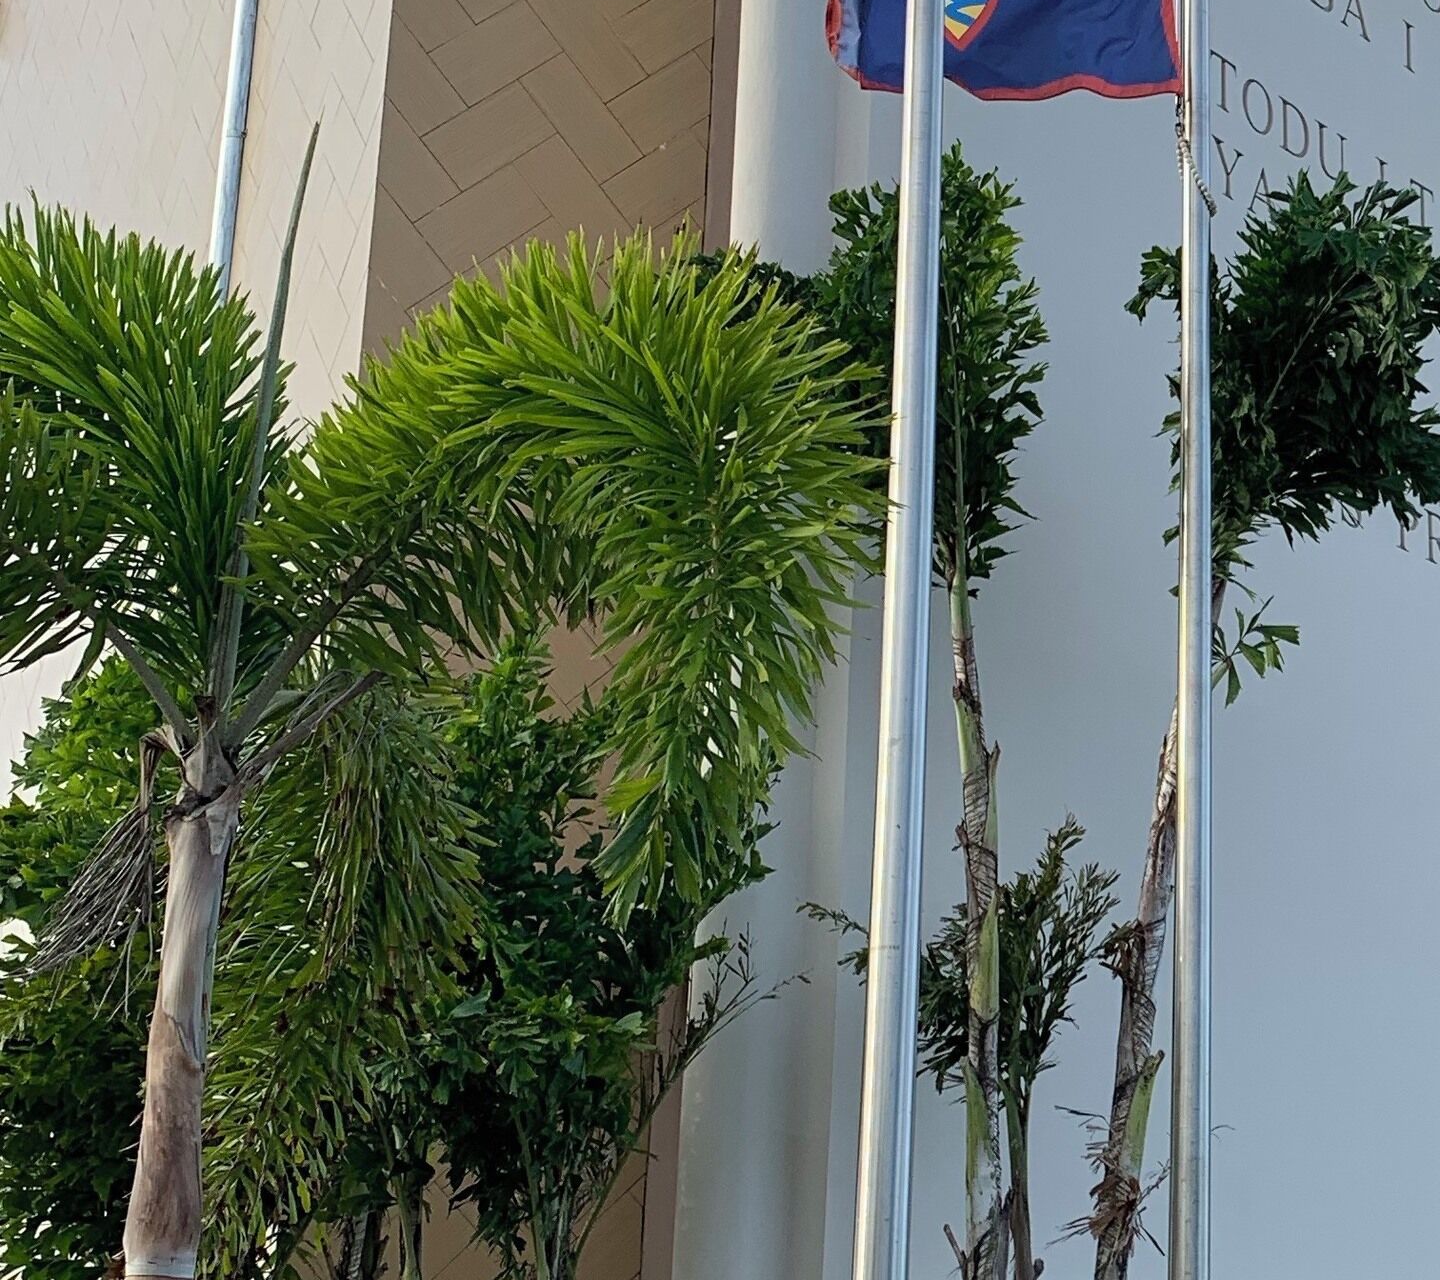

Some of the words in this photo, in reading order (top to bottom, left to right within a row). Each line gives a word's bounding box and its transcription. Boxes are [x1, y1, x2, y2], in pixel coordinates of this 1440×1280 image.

[1402, 19, 1415, 75] I
[1209, 50, 1348, 182] TODU
[1211, 134, 1276, 214] YA
